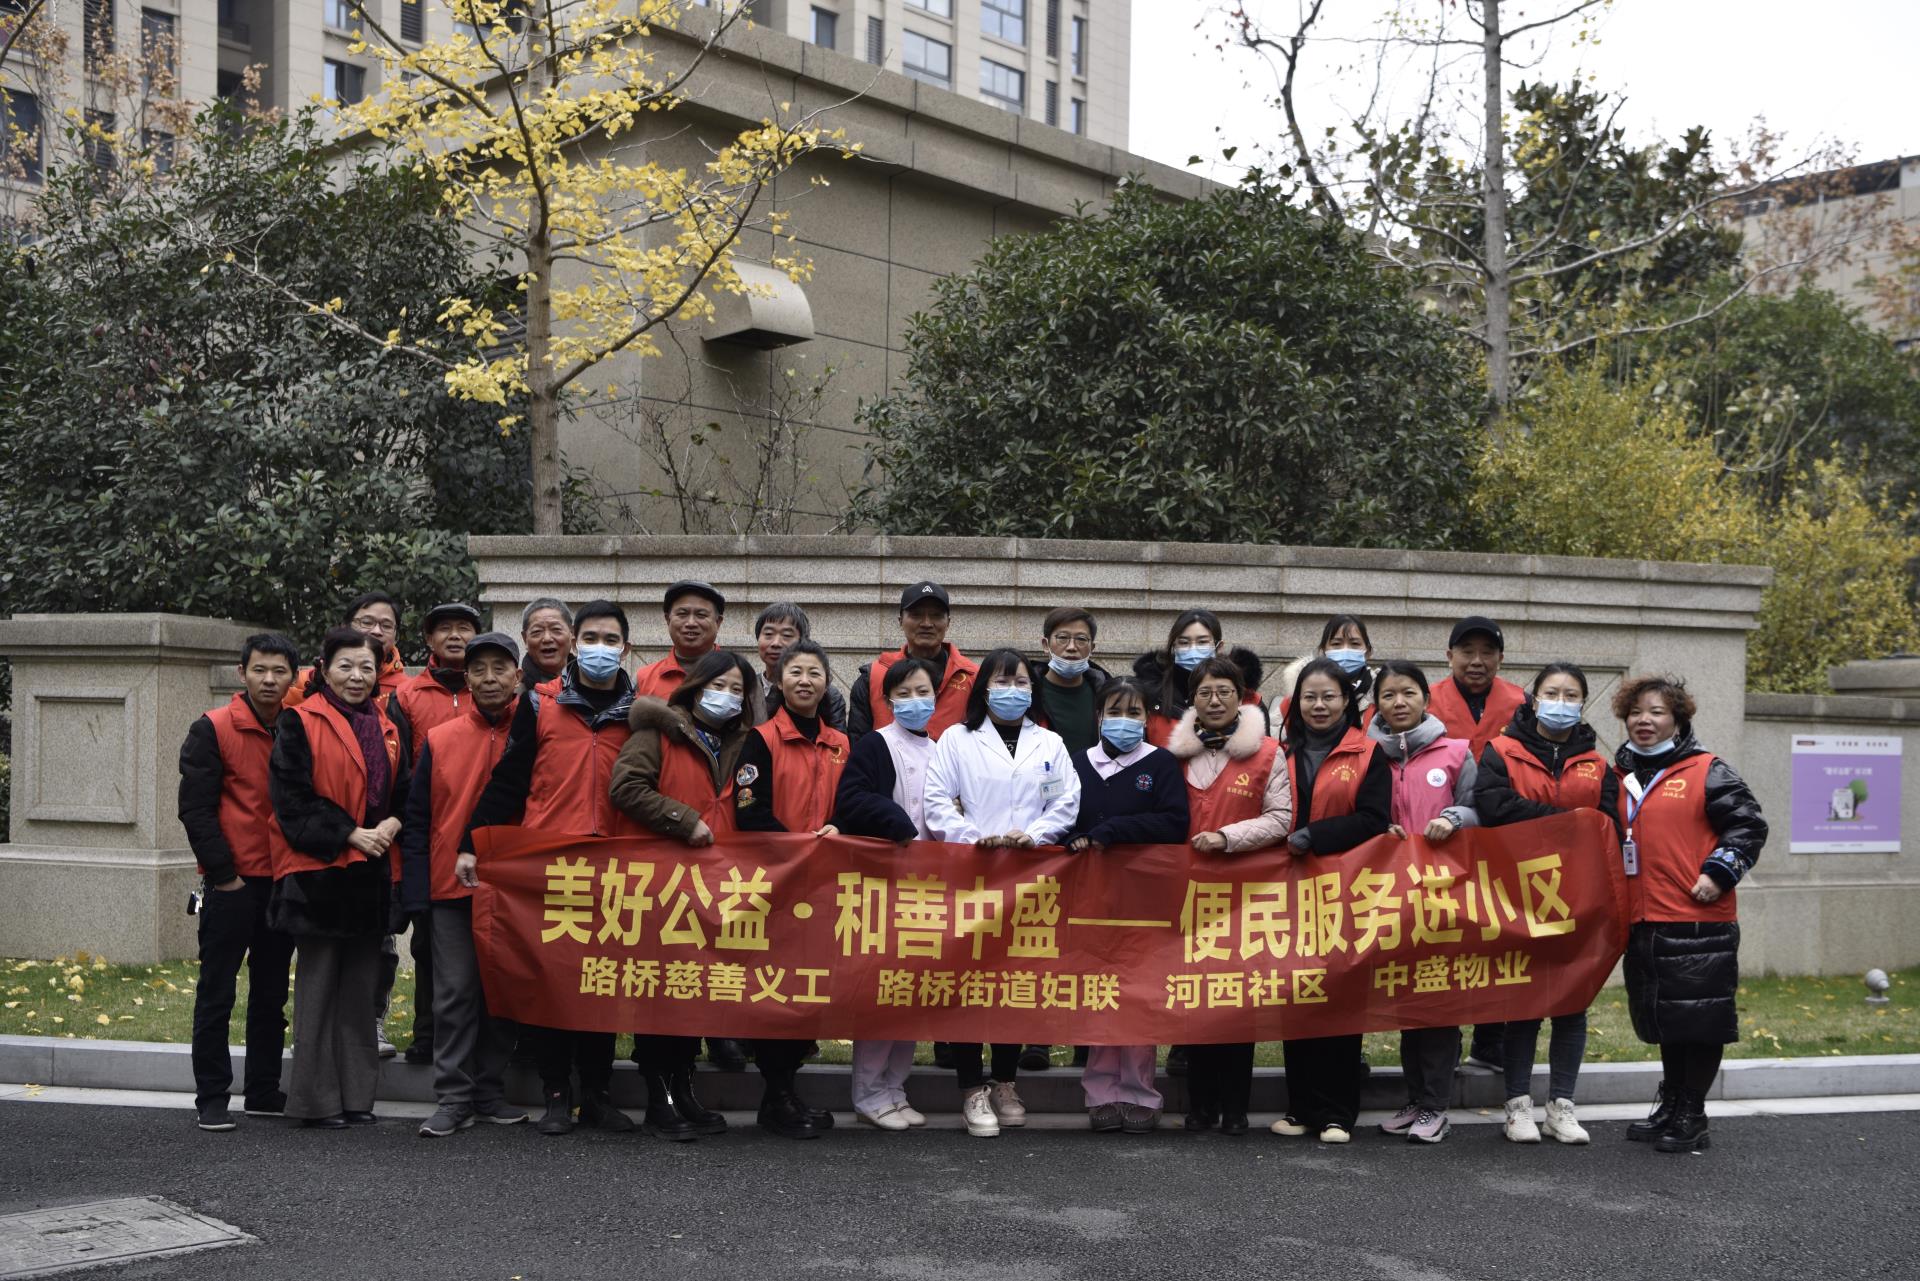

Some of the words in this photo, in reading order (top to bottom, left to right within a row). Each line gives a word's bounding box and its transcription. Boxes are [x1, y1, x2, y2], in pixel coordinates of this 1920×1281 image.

[579, 957, 831, 1004] 路桥慈善义工
[877, 969, 1121, 1012] 路桥街道妇联
[1165, 969, 1329, 1010] 河西社区
[1374, 950, 1533, 998] 中盛物业
